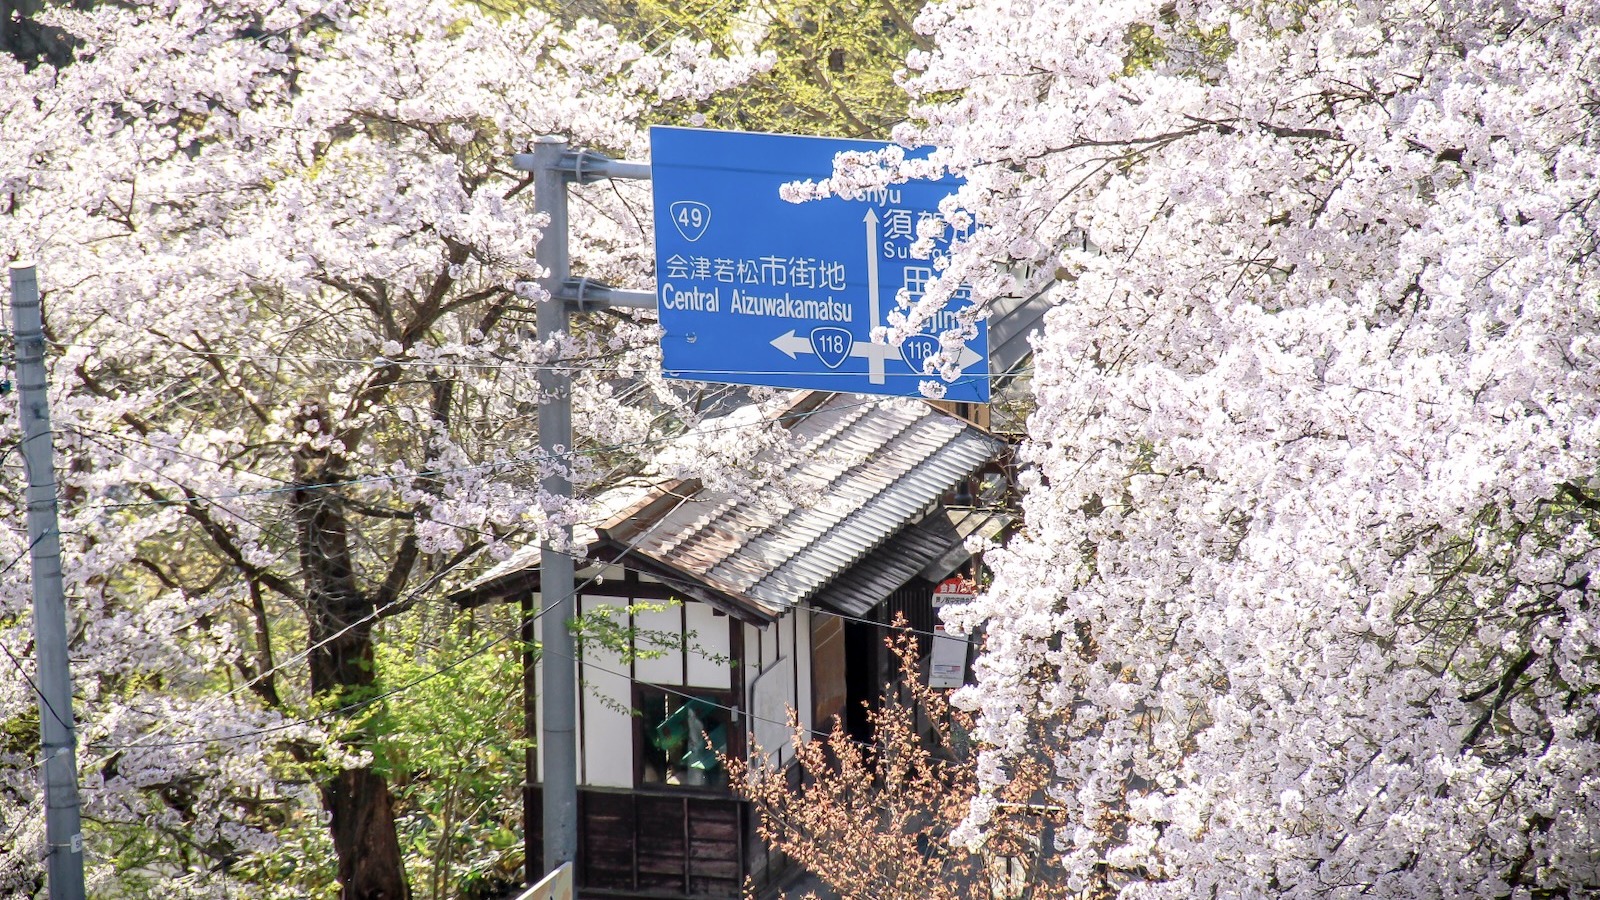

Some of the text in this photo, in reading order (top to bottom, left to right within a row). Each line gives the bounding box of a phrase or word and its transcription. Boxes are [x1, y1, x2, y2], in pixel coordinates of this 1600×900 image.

[678, 207, 702, 228] 49
[666, 253, 847, 291] 会津若松市街地
[662, 283, 852, 322] Central Aizuwakamatsu
[819, 335, 844, 354] 118
[908, 341, 933, 361] 118
